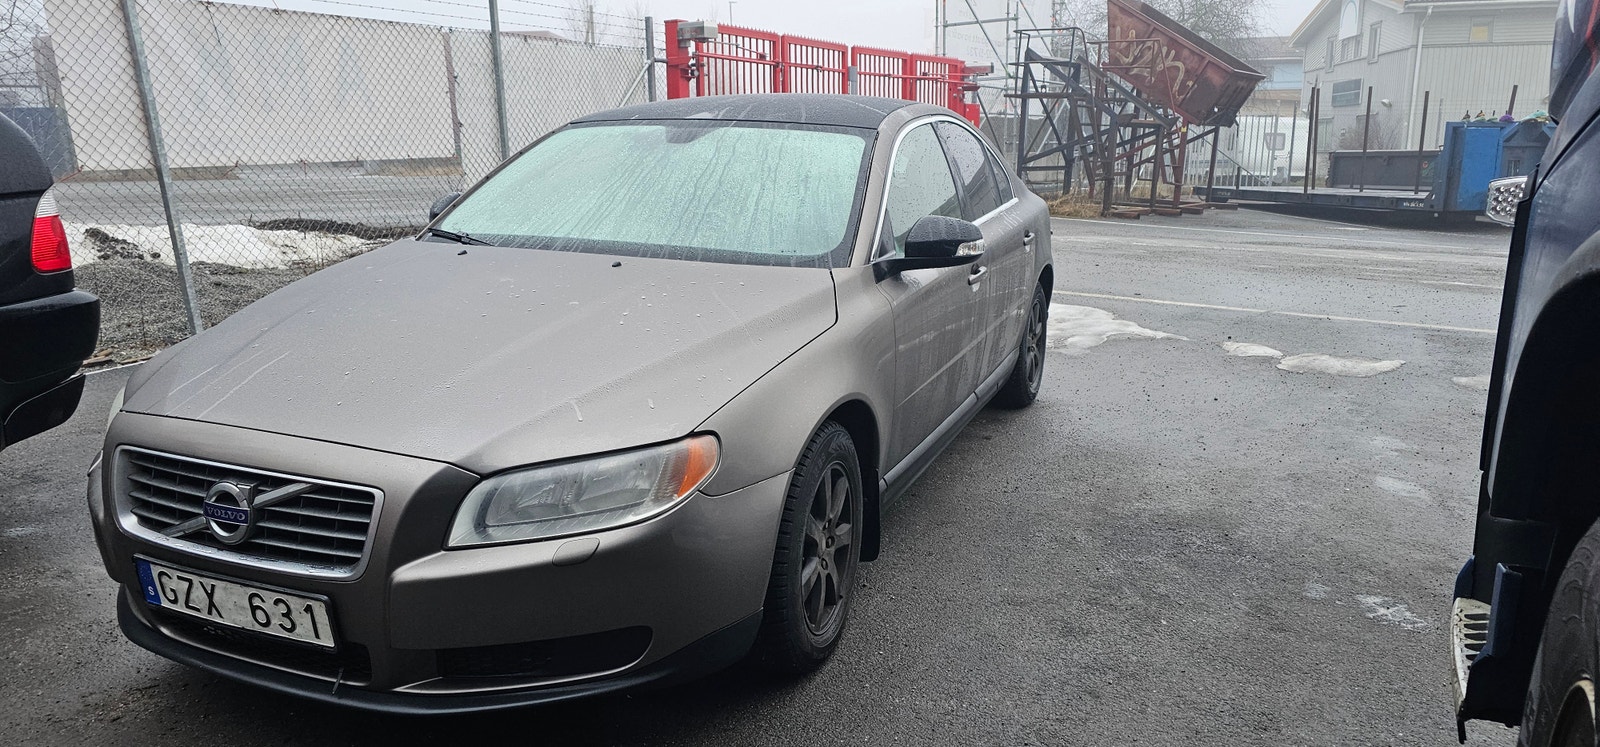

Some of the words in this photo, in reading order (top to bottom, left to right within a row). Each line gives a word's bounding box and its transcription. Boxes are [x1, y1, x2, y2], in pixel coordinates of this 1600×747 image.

[205, 505, 246, 521] VOLVO
[147, 585, 155, 596] S
[157, 570, 225, 619] GZX
[248, 592, 321, 640] 631
